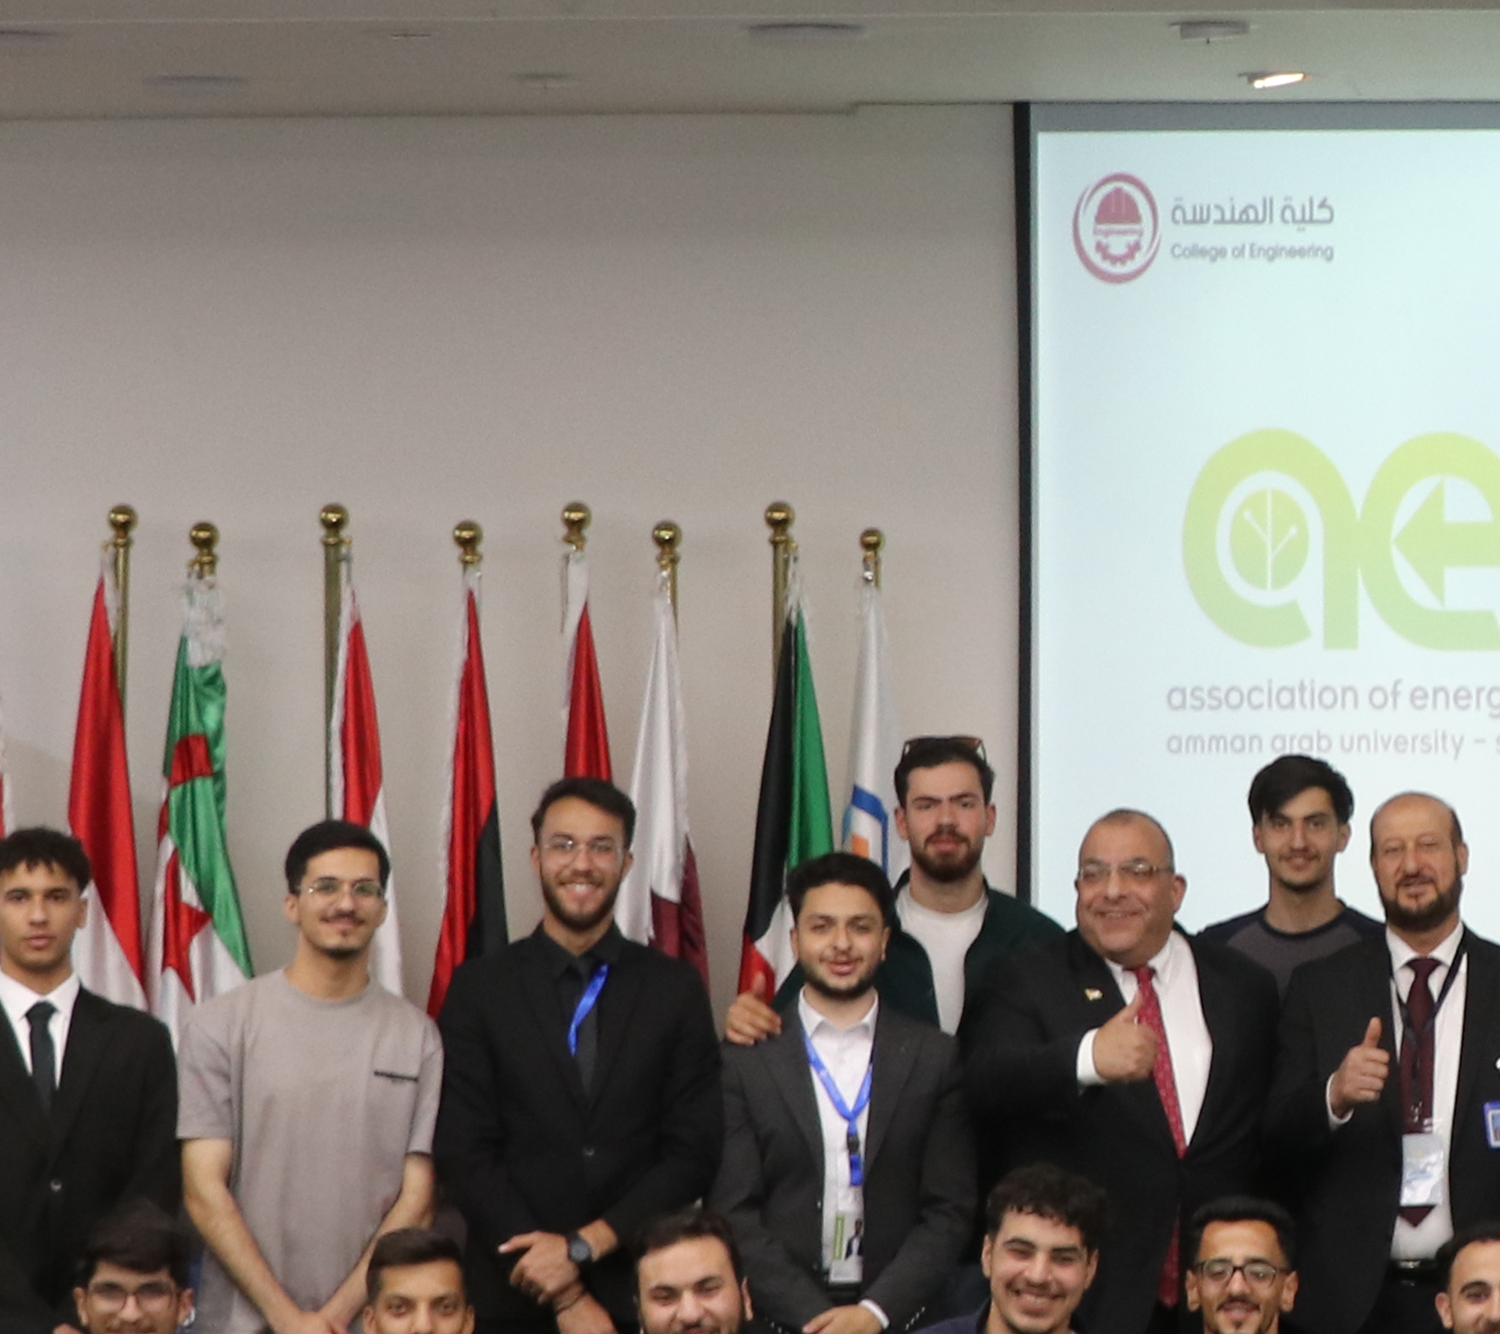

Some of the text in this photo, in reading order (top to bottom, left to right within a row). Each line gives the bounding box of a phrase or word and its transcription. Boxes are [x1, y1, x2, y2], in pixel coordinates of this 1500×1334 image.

[1169, 195, 1336, 231] كلية الهندسة
[1170, 243, 1334, 263] College of Engineering
[1165, 679, 1359, 713] association
[1368, 679, 1402, 711] of
[1166, 733, 1263, 755] amman
[1270, 729, 1333, 757] arab
[1340, 729, 1465, 760] university
